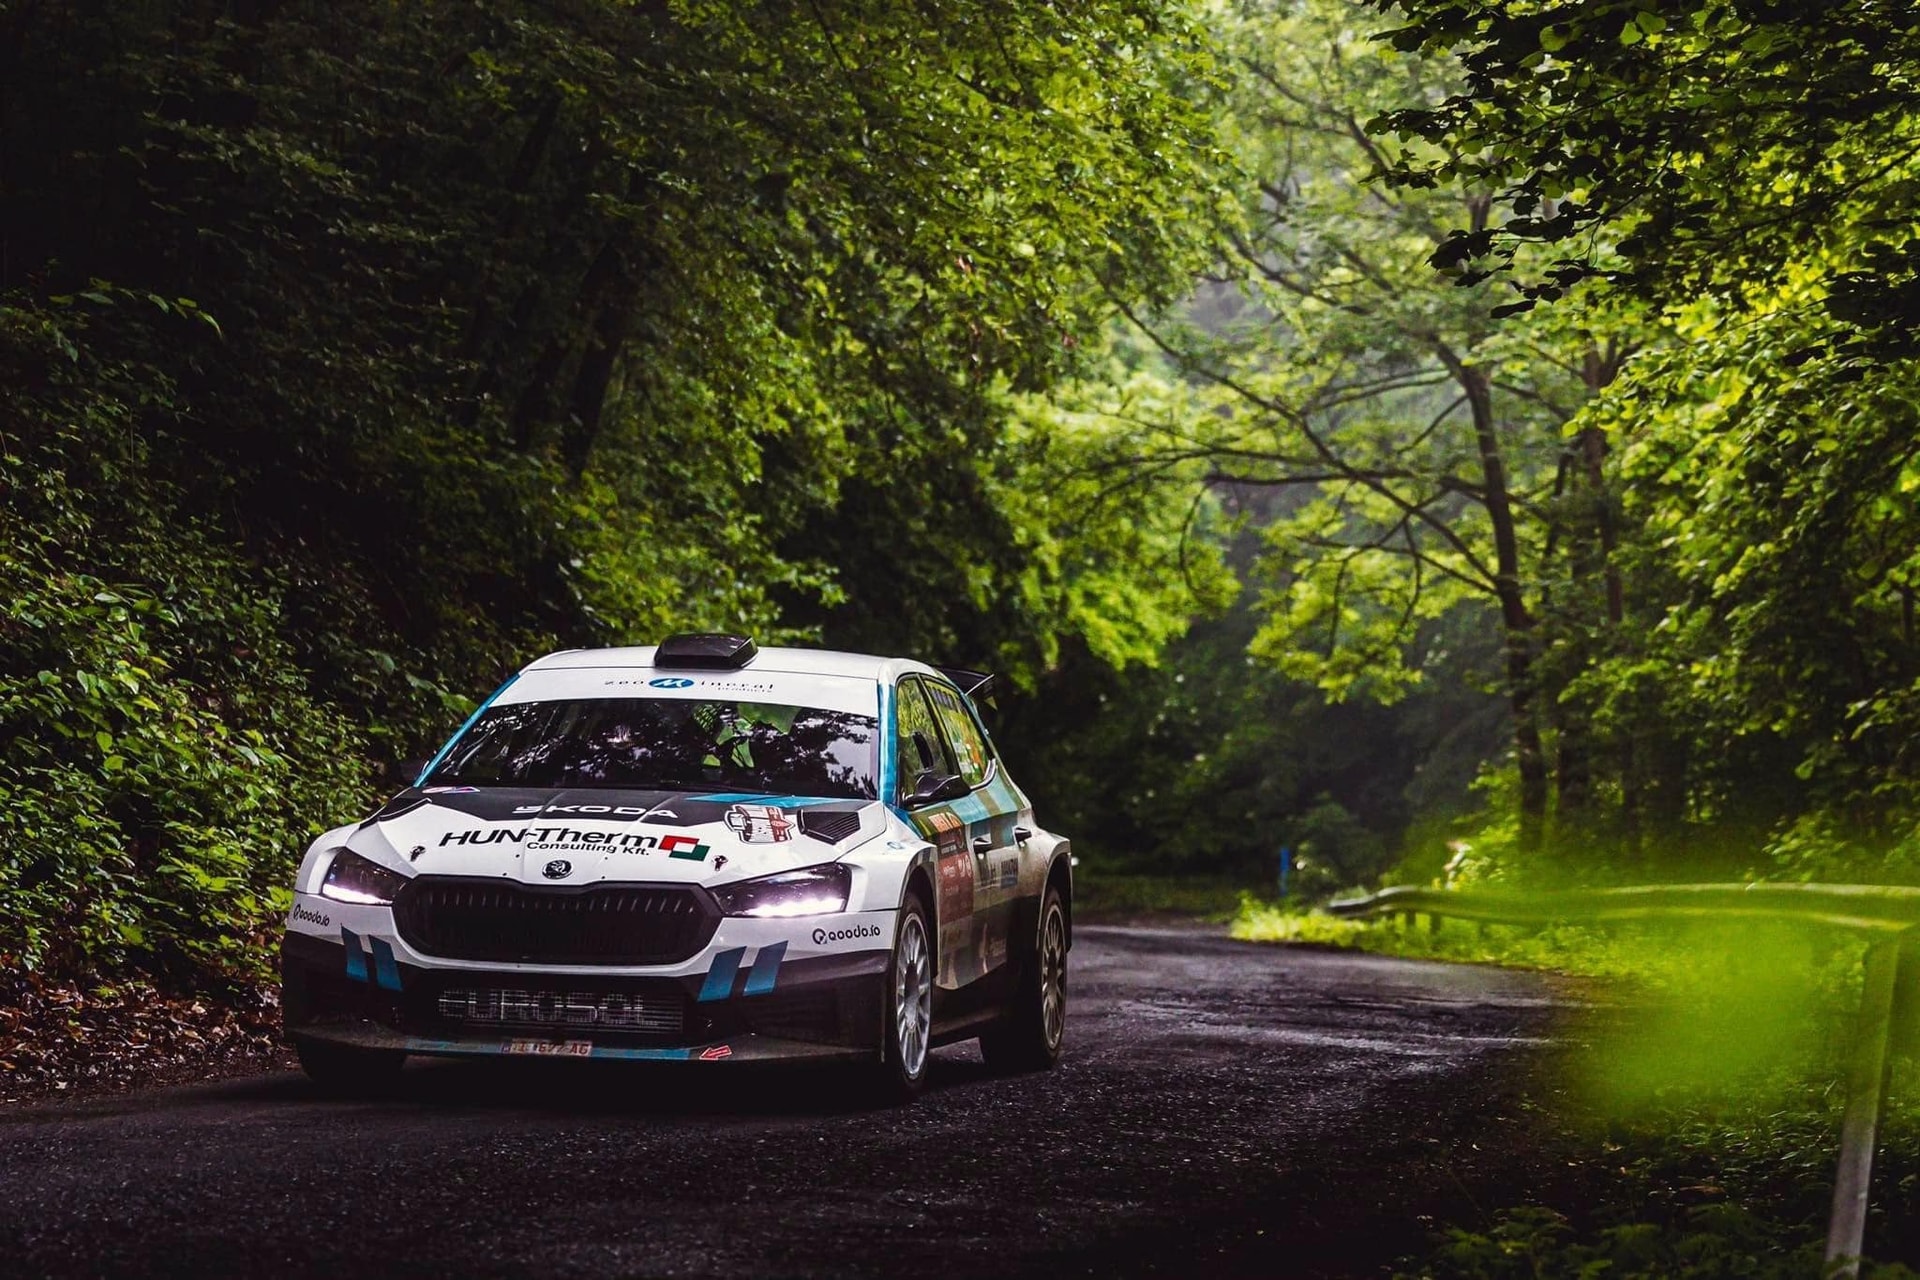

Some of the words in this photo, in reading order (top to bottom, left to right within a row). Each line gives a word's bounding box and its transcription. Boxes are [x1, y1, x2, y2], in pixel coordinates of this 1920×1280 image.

[438, 827, 659, 849] HUN-Therm
[526, 841, 617, 855] Consulting
[622, 846, 651, 856] Kft.
[438, 989, 659, 1027] EUROSOL
